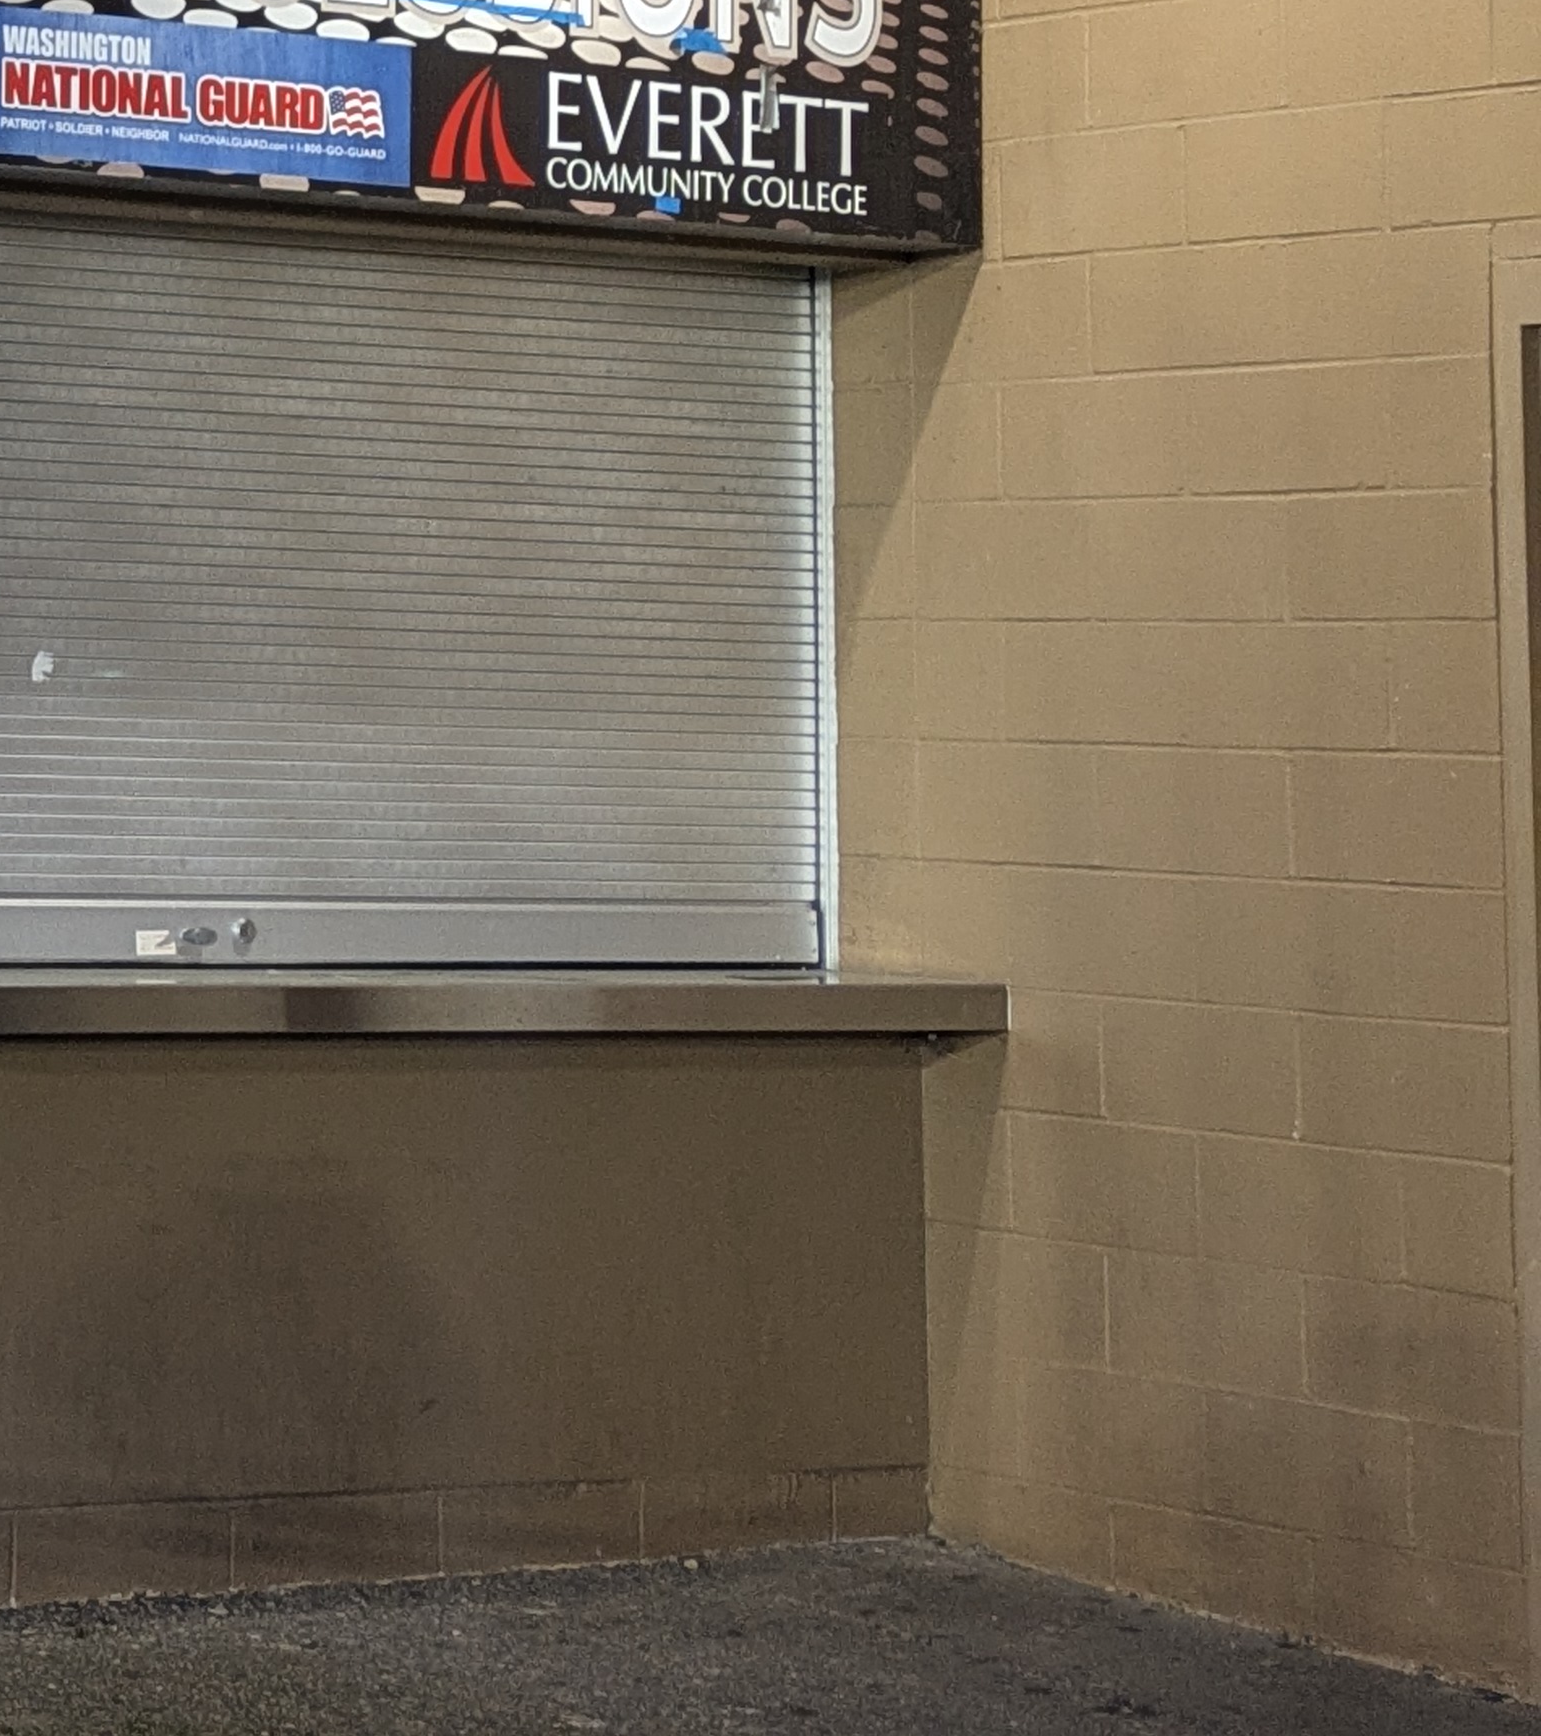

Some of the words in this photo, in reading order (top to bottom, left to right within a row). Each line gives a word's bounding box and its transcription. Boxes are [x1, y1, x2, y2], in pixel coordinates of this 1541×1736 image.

[2, 24, 152, 65] WASHINGTON
[1, 60, 191, 123] NATIONAL
[196, 75, 328, 134] GUARD
[546, 71, 869, 177] EVERETT
[0, 116, 47, 131] PATRIOT
[55, 121, 104, 136] SOLDIER
[111, 126, 170, 142] NEIGHBOR
[546, 156, 735, 205] COMMUNITY
[742, 175, 868, 216] COLLEGE
